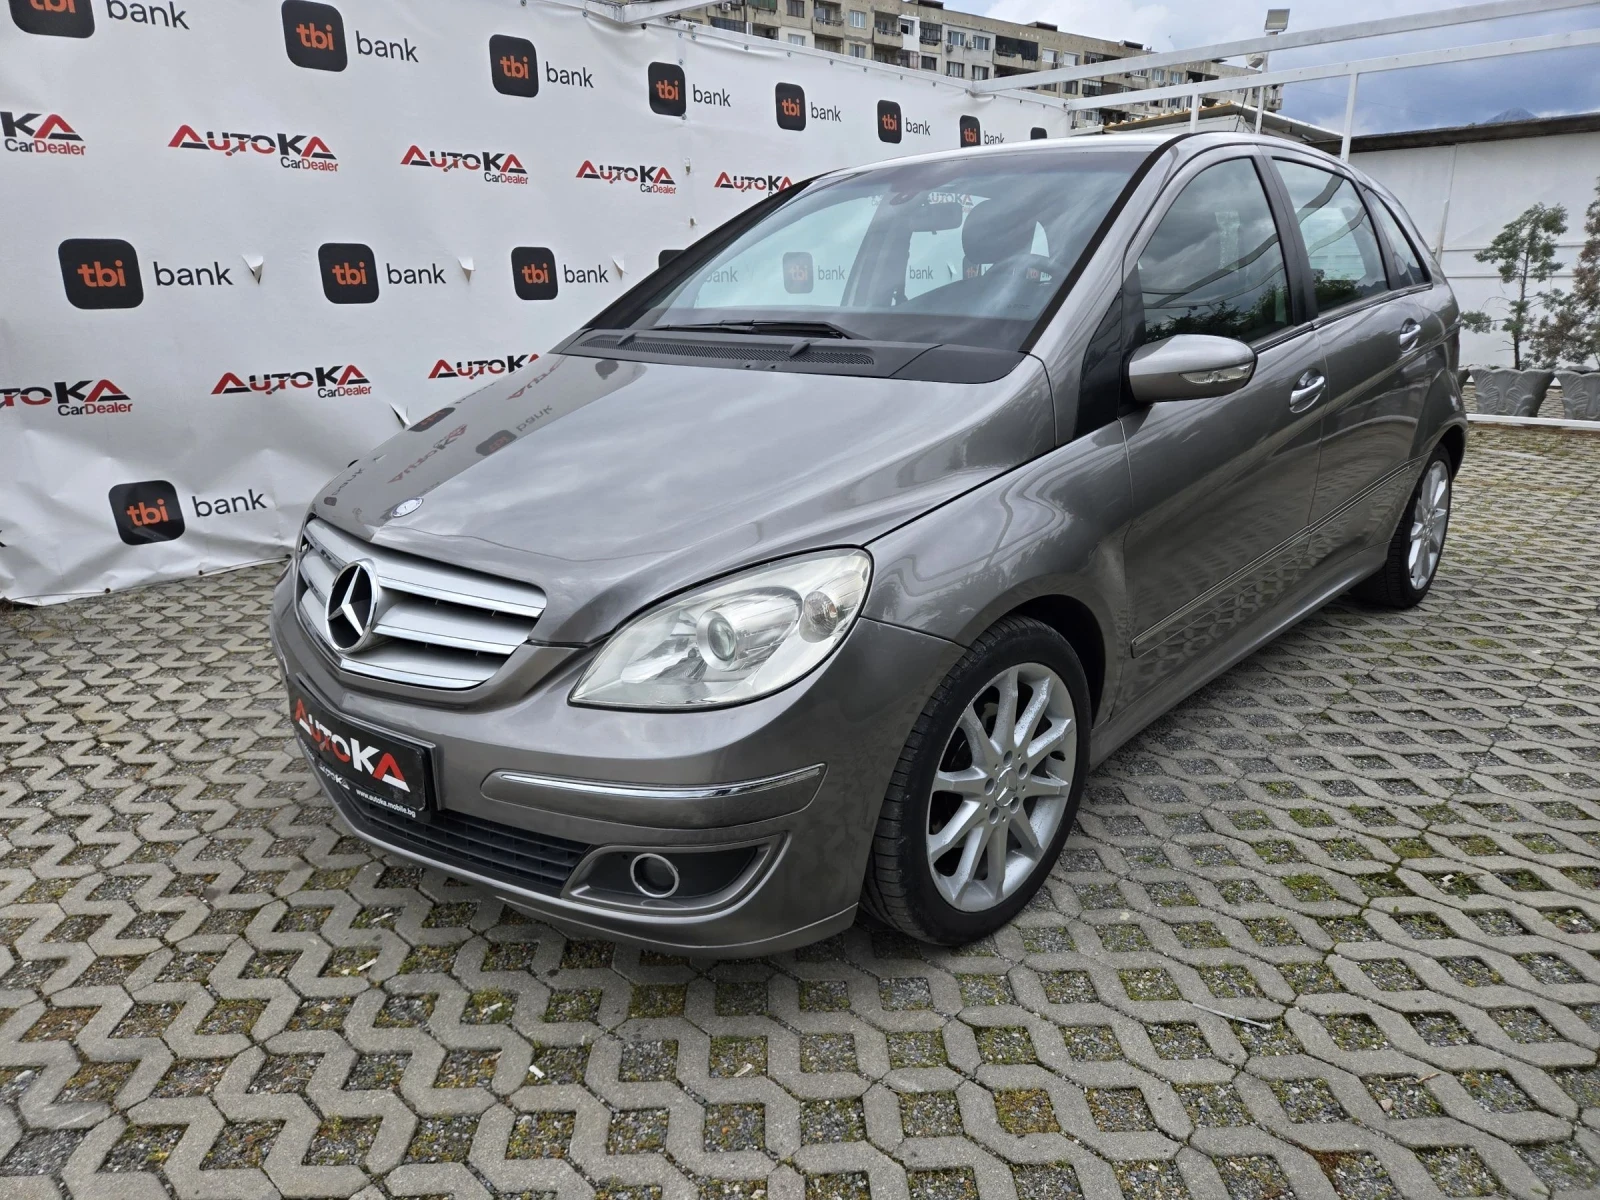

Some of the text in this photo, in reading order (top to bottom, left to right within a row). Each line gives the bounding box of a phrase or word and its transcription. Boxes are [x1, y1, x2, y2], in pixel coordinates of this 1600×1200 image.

[106, 0, 190, 30] bank
[296, 23, 419, 63] tbi bank
[500, 56, 594, 88] tbi bank
[656, 81, 731, 107] tbi bank
[782, 99, 842, 123] tbi bank
[882, 115, 931, 136] tbi bank
[964, 128, 977, 143] tbi
[5, 138, 86, 156] CarDealer
[280, 156, 338, 172] CarDealer
[484, 172, 528, 185] CarDealer
[640, 183, 676, 195] CarDealer
[77, 260, 234, 288] tbi bank
[332, 261, 446, 285] tbi bank
[522, 263, 609, 284] tbi bank
[818, 265, 846, 280] bank
[909, 266, 934, 280] bank
[317, 384, 372, 398] CarDealer
[57, 402, 133, 416] CarDealer
[127, 489, 267, 527] tbi bank
